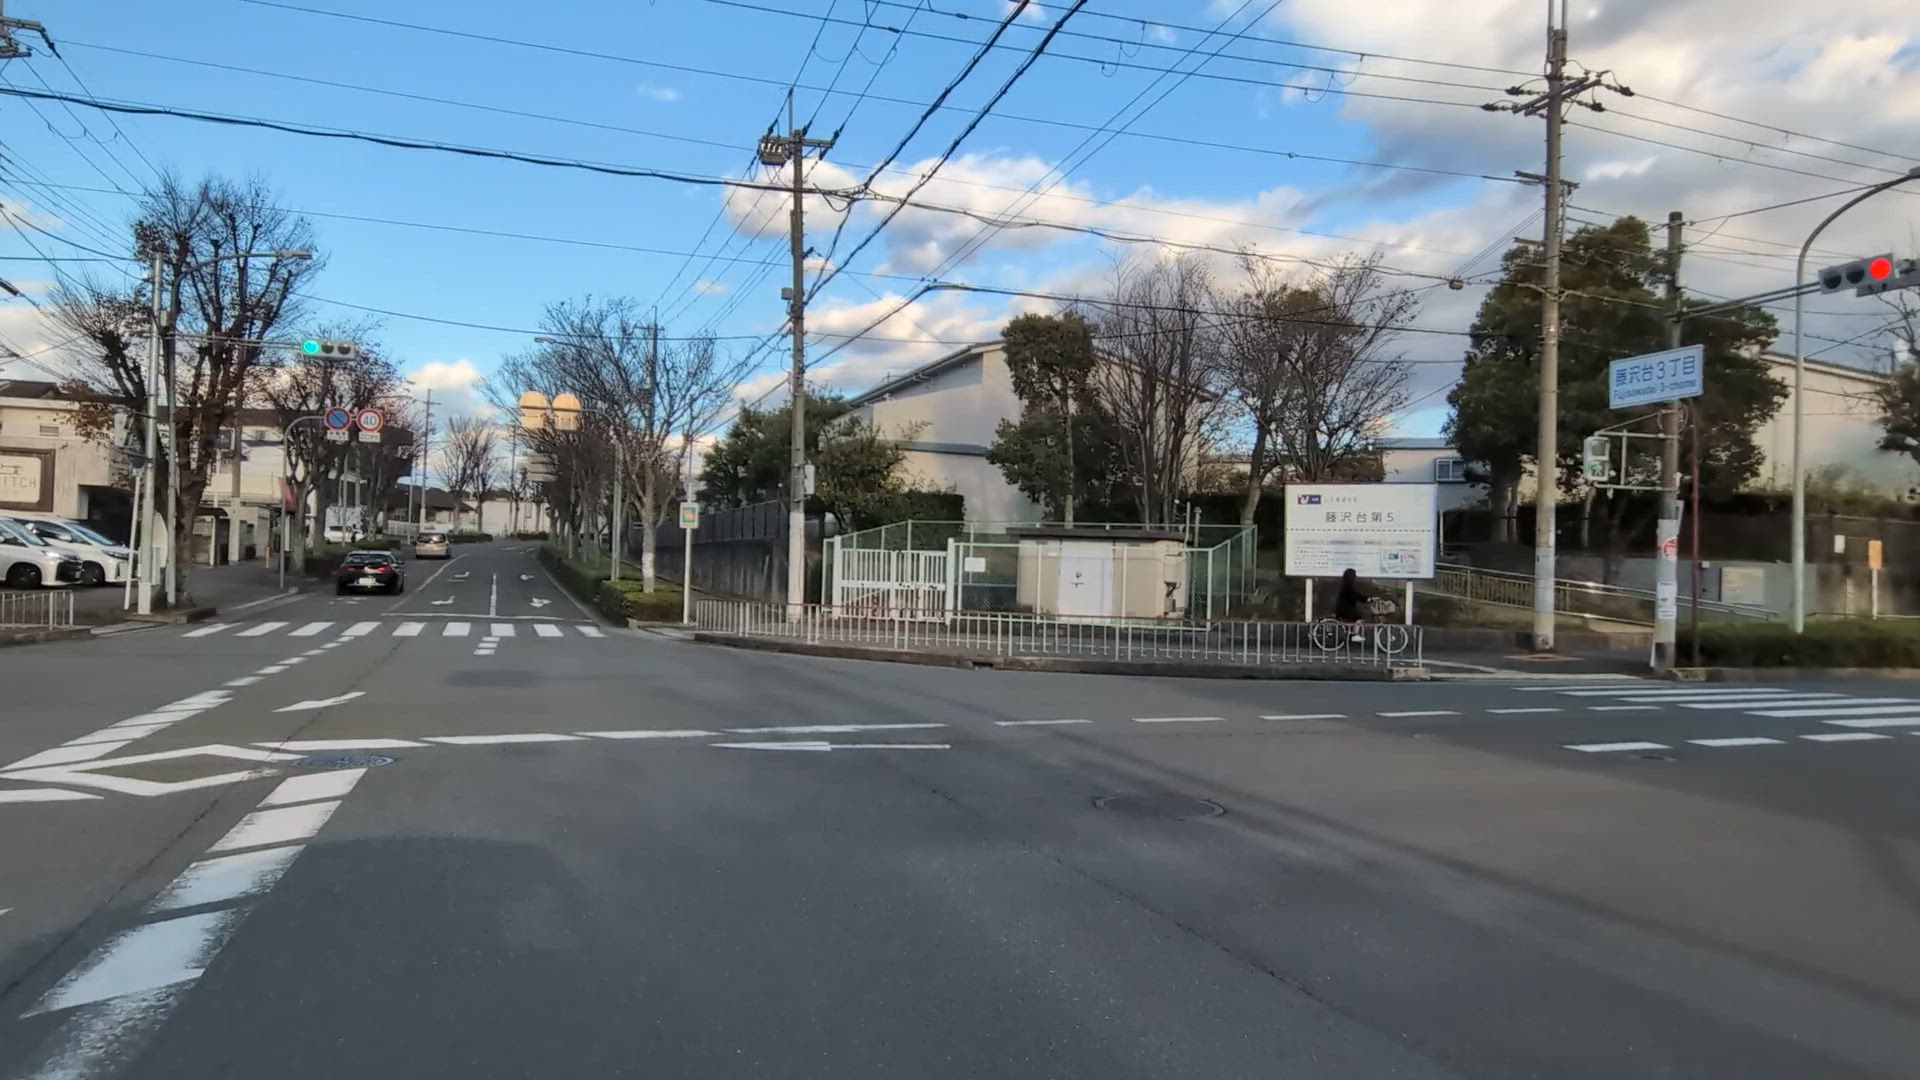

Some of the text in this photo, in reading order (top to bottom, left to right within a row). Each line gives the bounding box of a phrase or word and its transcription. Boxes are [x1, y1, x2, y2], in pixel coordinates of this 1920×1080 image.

[1615, 355, 1696, 387] 藤沢台3丁目
[363, 414, 377, 426] 40
